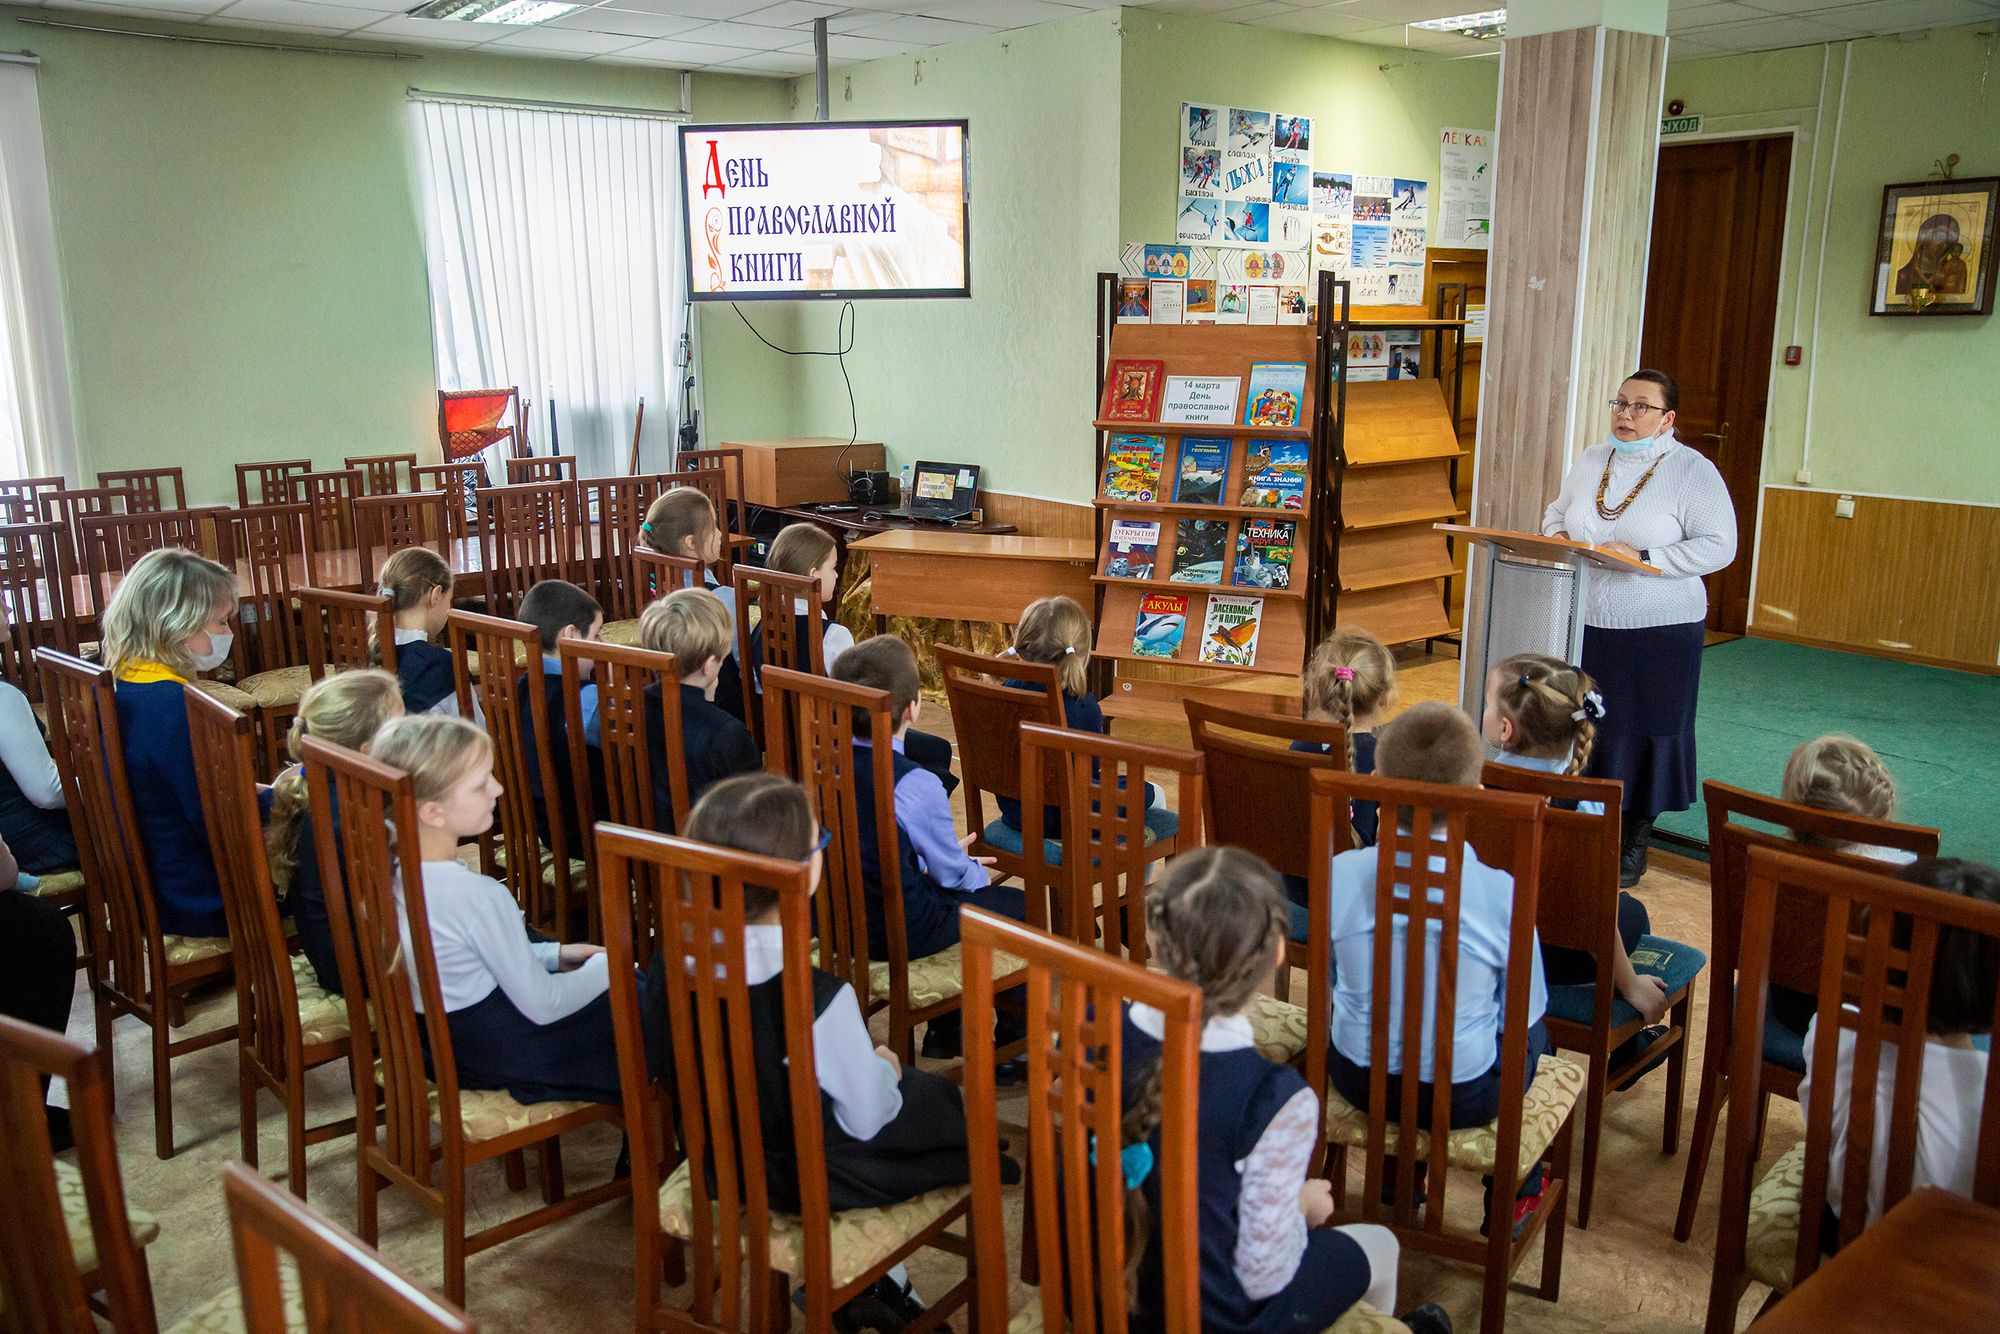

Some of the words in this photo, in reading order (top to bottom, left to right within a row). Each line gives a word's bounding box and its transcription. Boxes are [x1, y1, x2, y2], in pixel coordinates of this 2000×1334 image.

[1661, 119, 1697, 133] ЫХОД
[1224, 158, 1265, 194] ЛЫЖИ
[1185, 189, 1214, 198] БИАТЛОН
[1184, 381, 1193, 389] 14
[1195, 383, 1221, 391] марта
[1189, 391, 1212, 401] День
[1168, 402, 1230, 411] православной
[1248, 475, 1272, 483] КНИГА
[1273, 476, 1303, 484] ЗНАНИЙ
[1114, 529, 1156, 538] ОТКРЫТИЯ
[1247, 527, 1290, 540] ТЕХНИКА
[1147, 600, 1183, 612] АКУЛЫ
[1213, 603, 1255, 616] НАСЕКОМЫЕ
[1225, 614, 1247, 625] ПАУКИ
